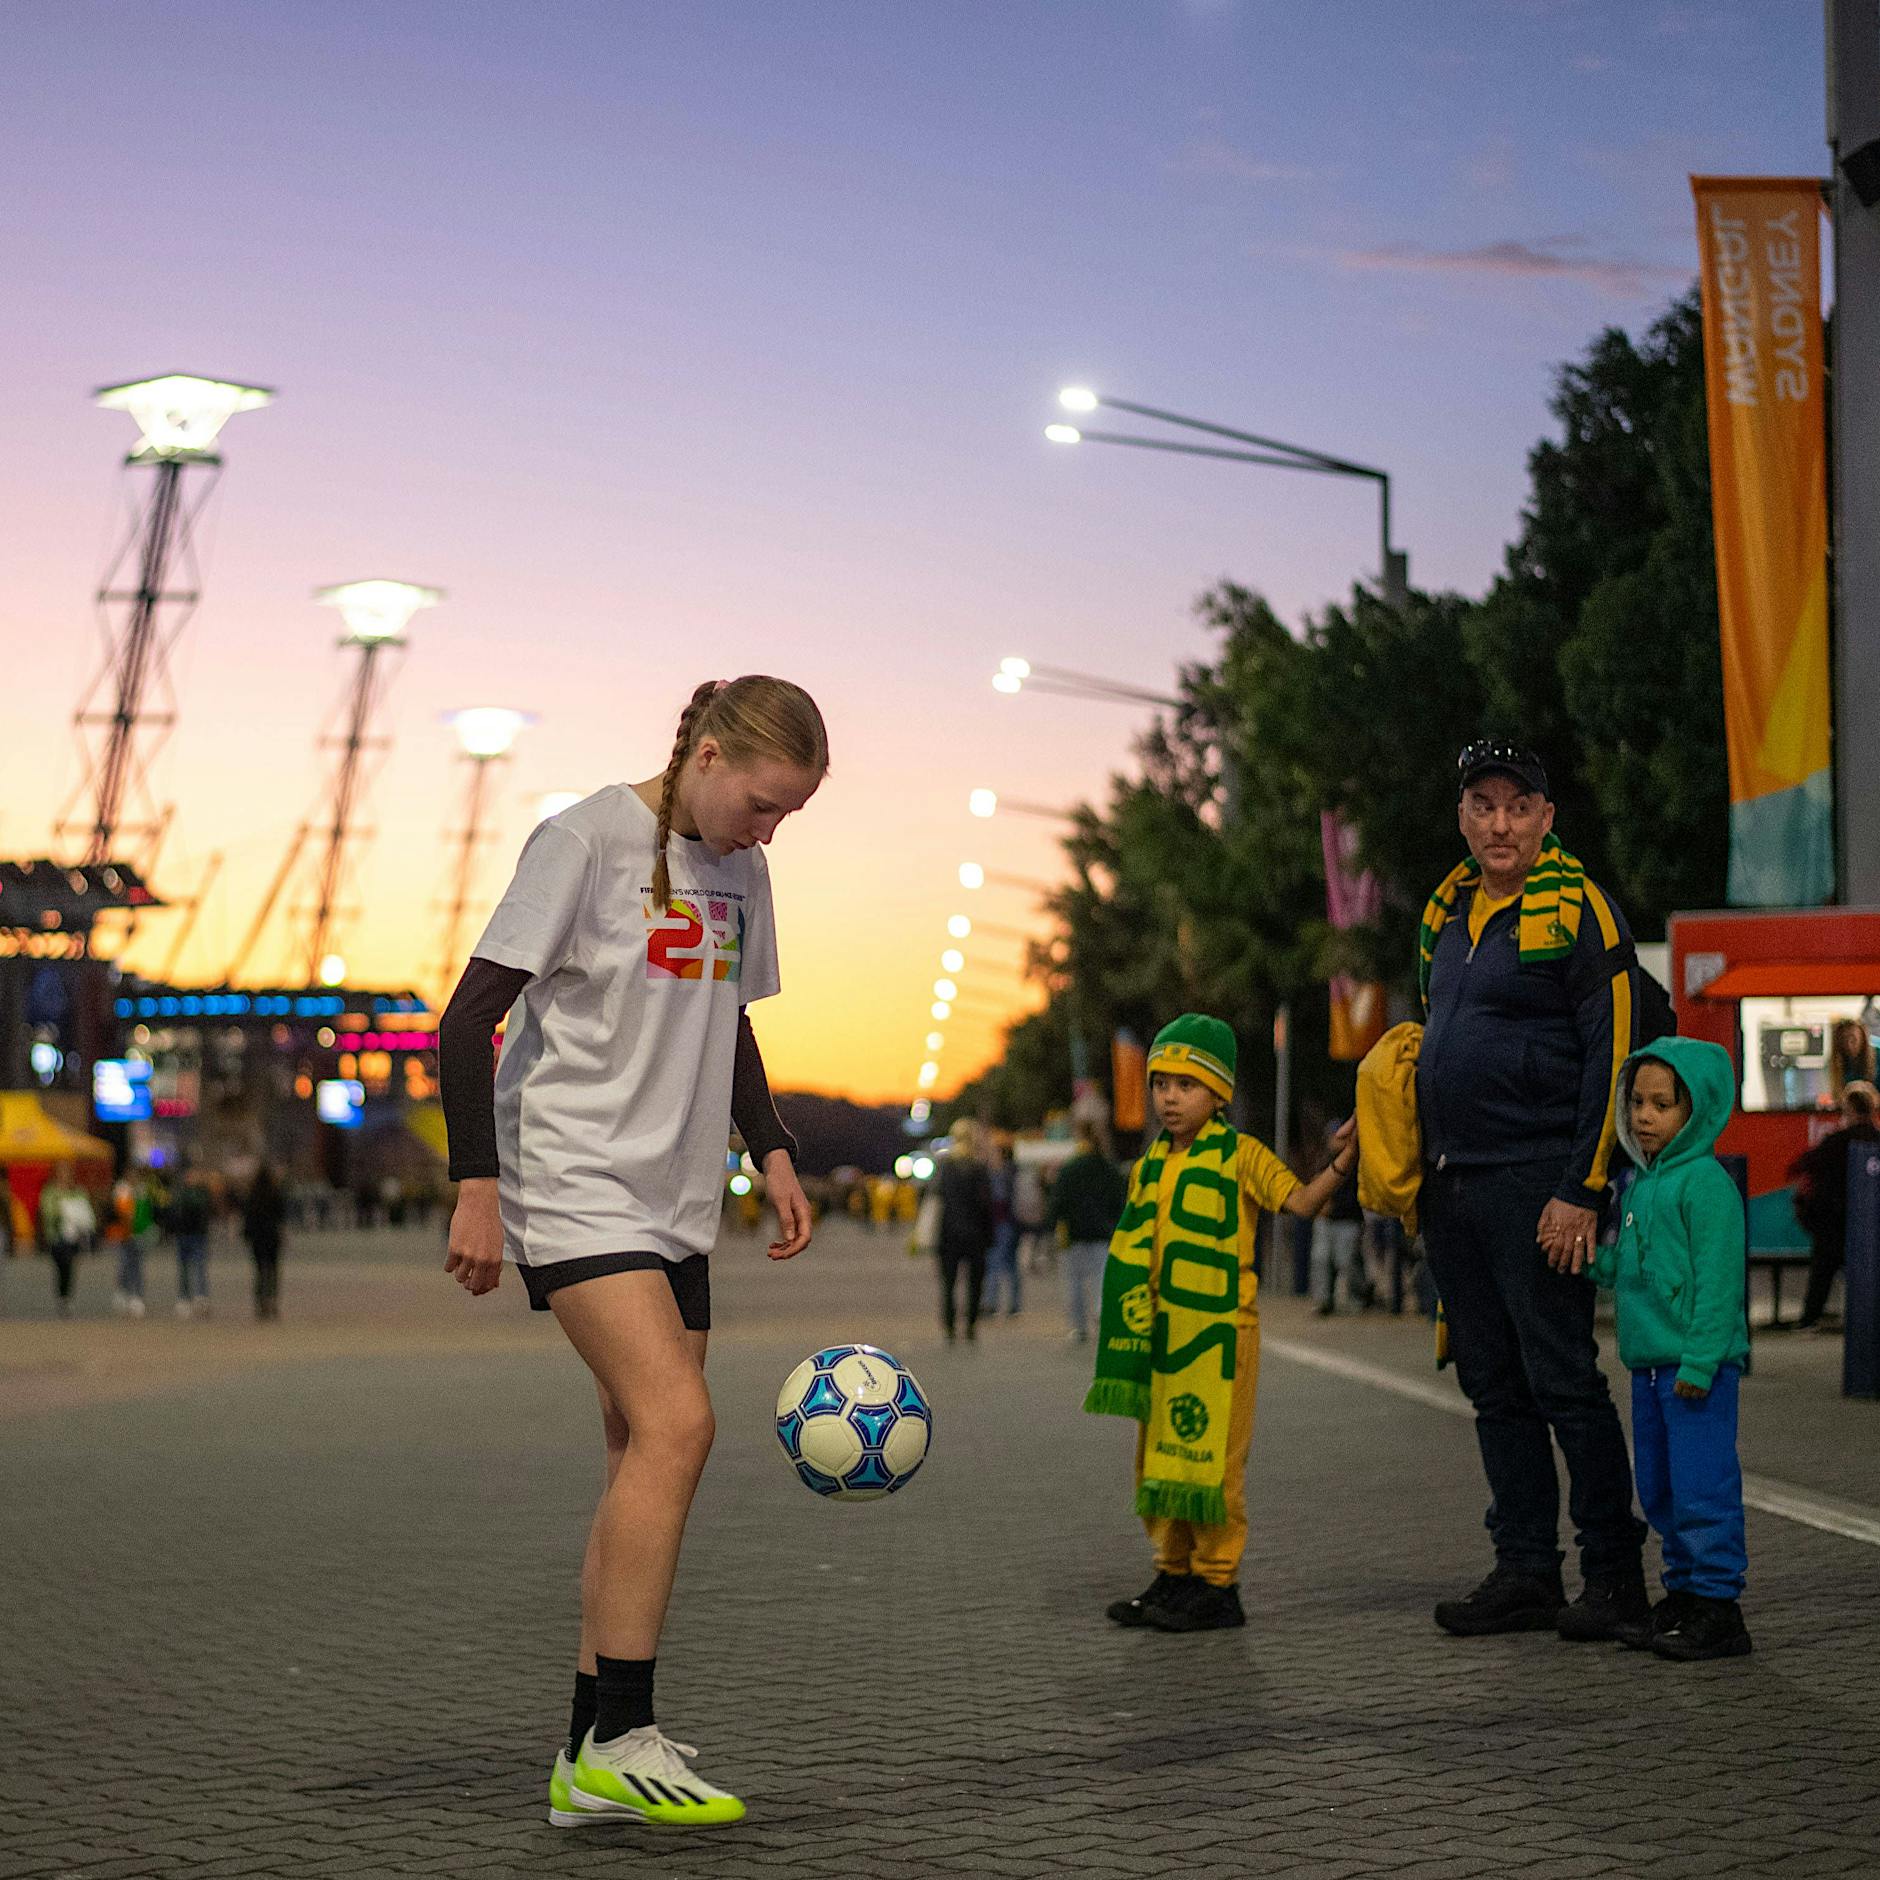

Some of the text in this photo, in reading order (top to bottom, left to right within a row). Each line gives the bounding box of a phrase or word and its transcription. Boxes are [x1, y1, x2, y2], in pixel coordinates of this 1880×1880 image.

[684, 889, 705, 897] WORLD
[1107, 1336, 1152, 1354] AUSTR
[1156, 1440, 1215, 1463] AUSTRALIA
